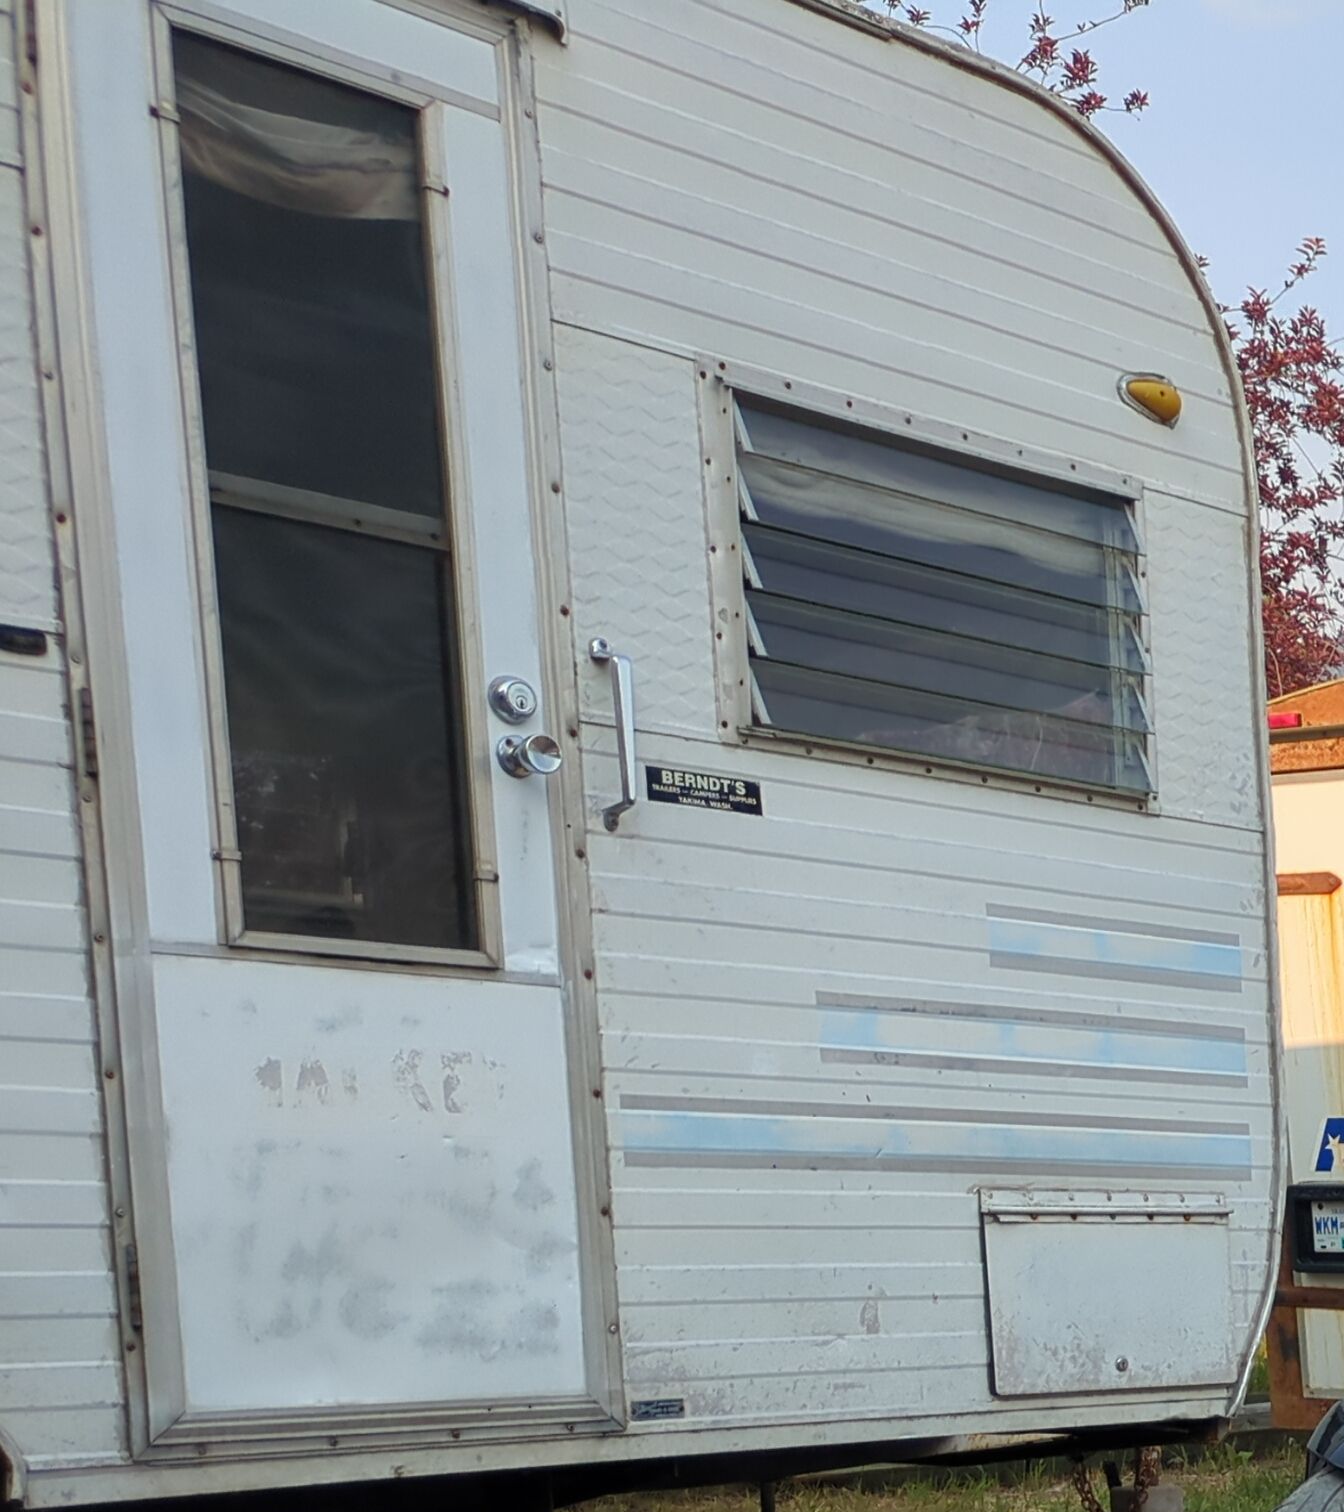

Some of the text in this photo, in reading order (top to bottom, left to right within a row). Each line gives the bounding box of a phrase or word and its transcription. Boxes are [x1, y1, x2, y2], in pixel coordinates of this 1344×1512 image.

[652, 783, 680, 794] TRAILERS
[690, 788, 720, 799] CAMPERS
[661, 770, 746, 795] BERNDT'S
